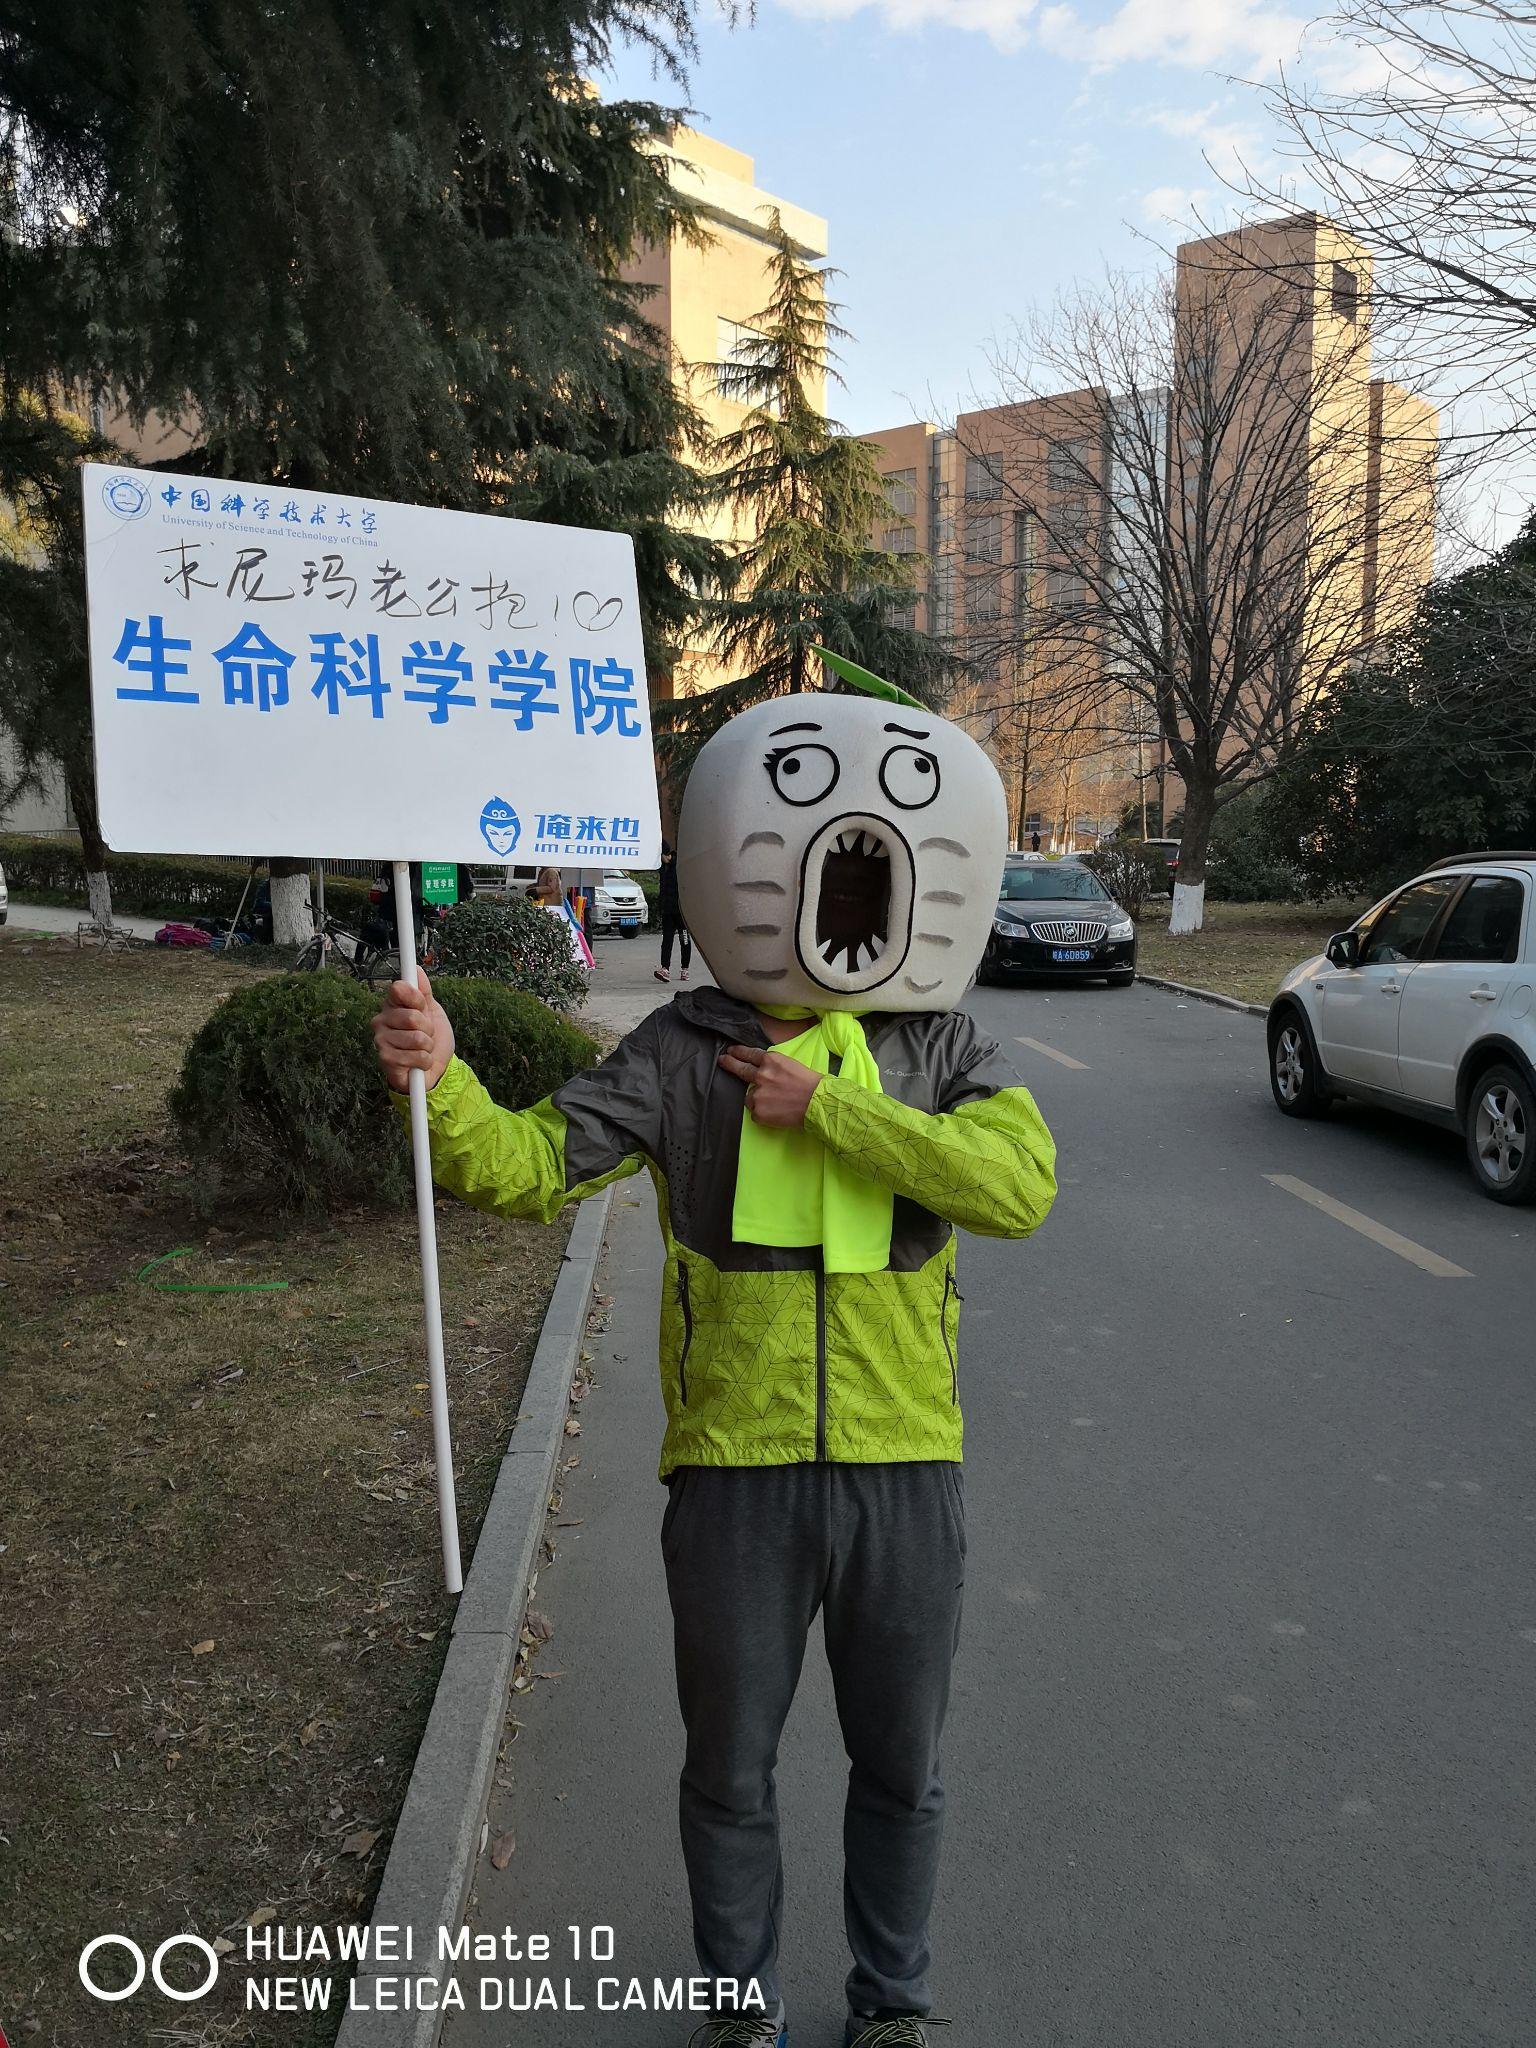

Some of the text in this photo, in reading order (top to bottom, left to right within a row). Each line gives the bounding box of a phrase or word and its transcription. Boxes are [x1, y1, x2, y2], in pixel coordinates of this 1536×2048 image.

[161, 485, 379, 534] 中国科学技术大学
[162, 514, 379, 548] University of Science and Technology of China
[112, 615, 642, 738] 生命科学学院
[534, 814, 641, 843] 俺来也
